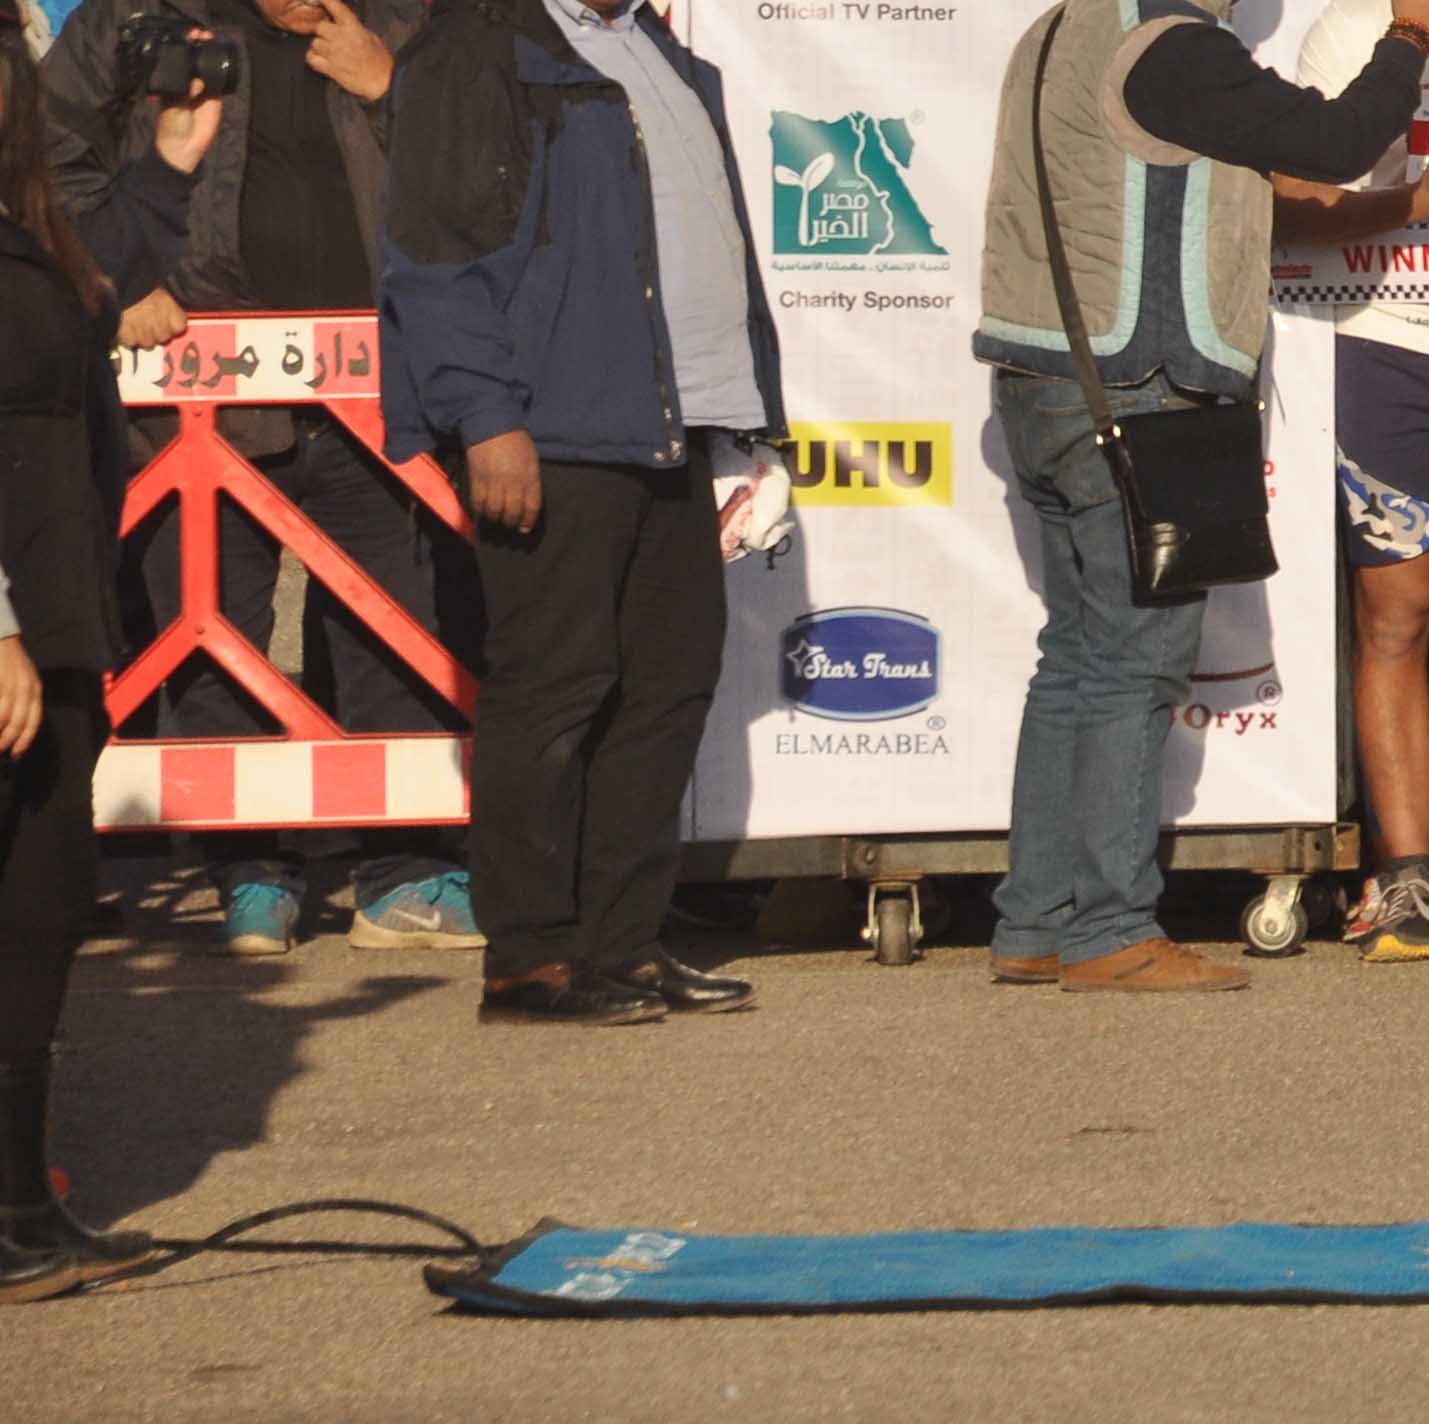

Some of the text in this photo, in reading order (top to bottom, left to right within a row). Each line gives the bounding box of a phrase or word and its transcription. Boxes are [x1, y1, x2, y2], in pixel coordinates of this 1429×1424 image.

[757, 2, 957, 23] Official TV Partner
[820, 192, 870, 217] مصر
[808, 211, 869, 247] الخير
[779, 290, 954, 312] Charity Sponsor
[151, 339, 260, 389] مرور
[281, 330, 371, 390] دارة
[791, 439, 934, 488] UHU
[803, 649, 933, 680] Star Trans
[775, 733, 950, 755] ELMARABEA
